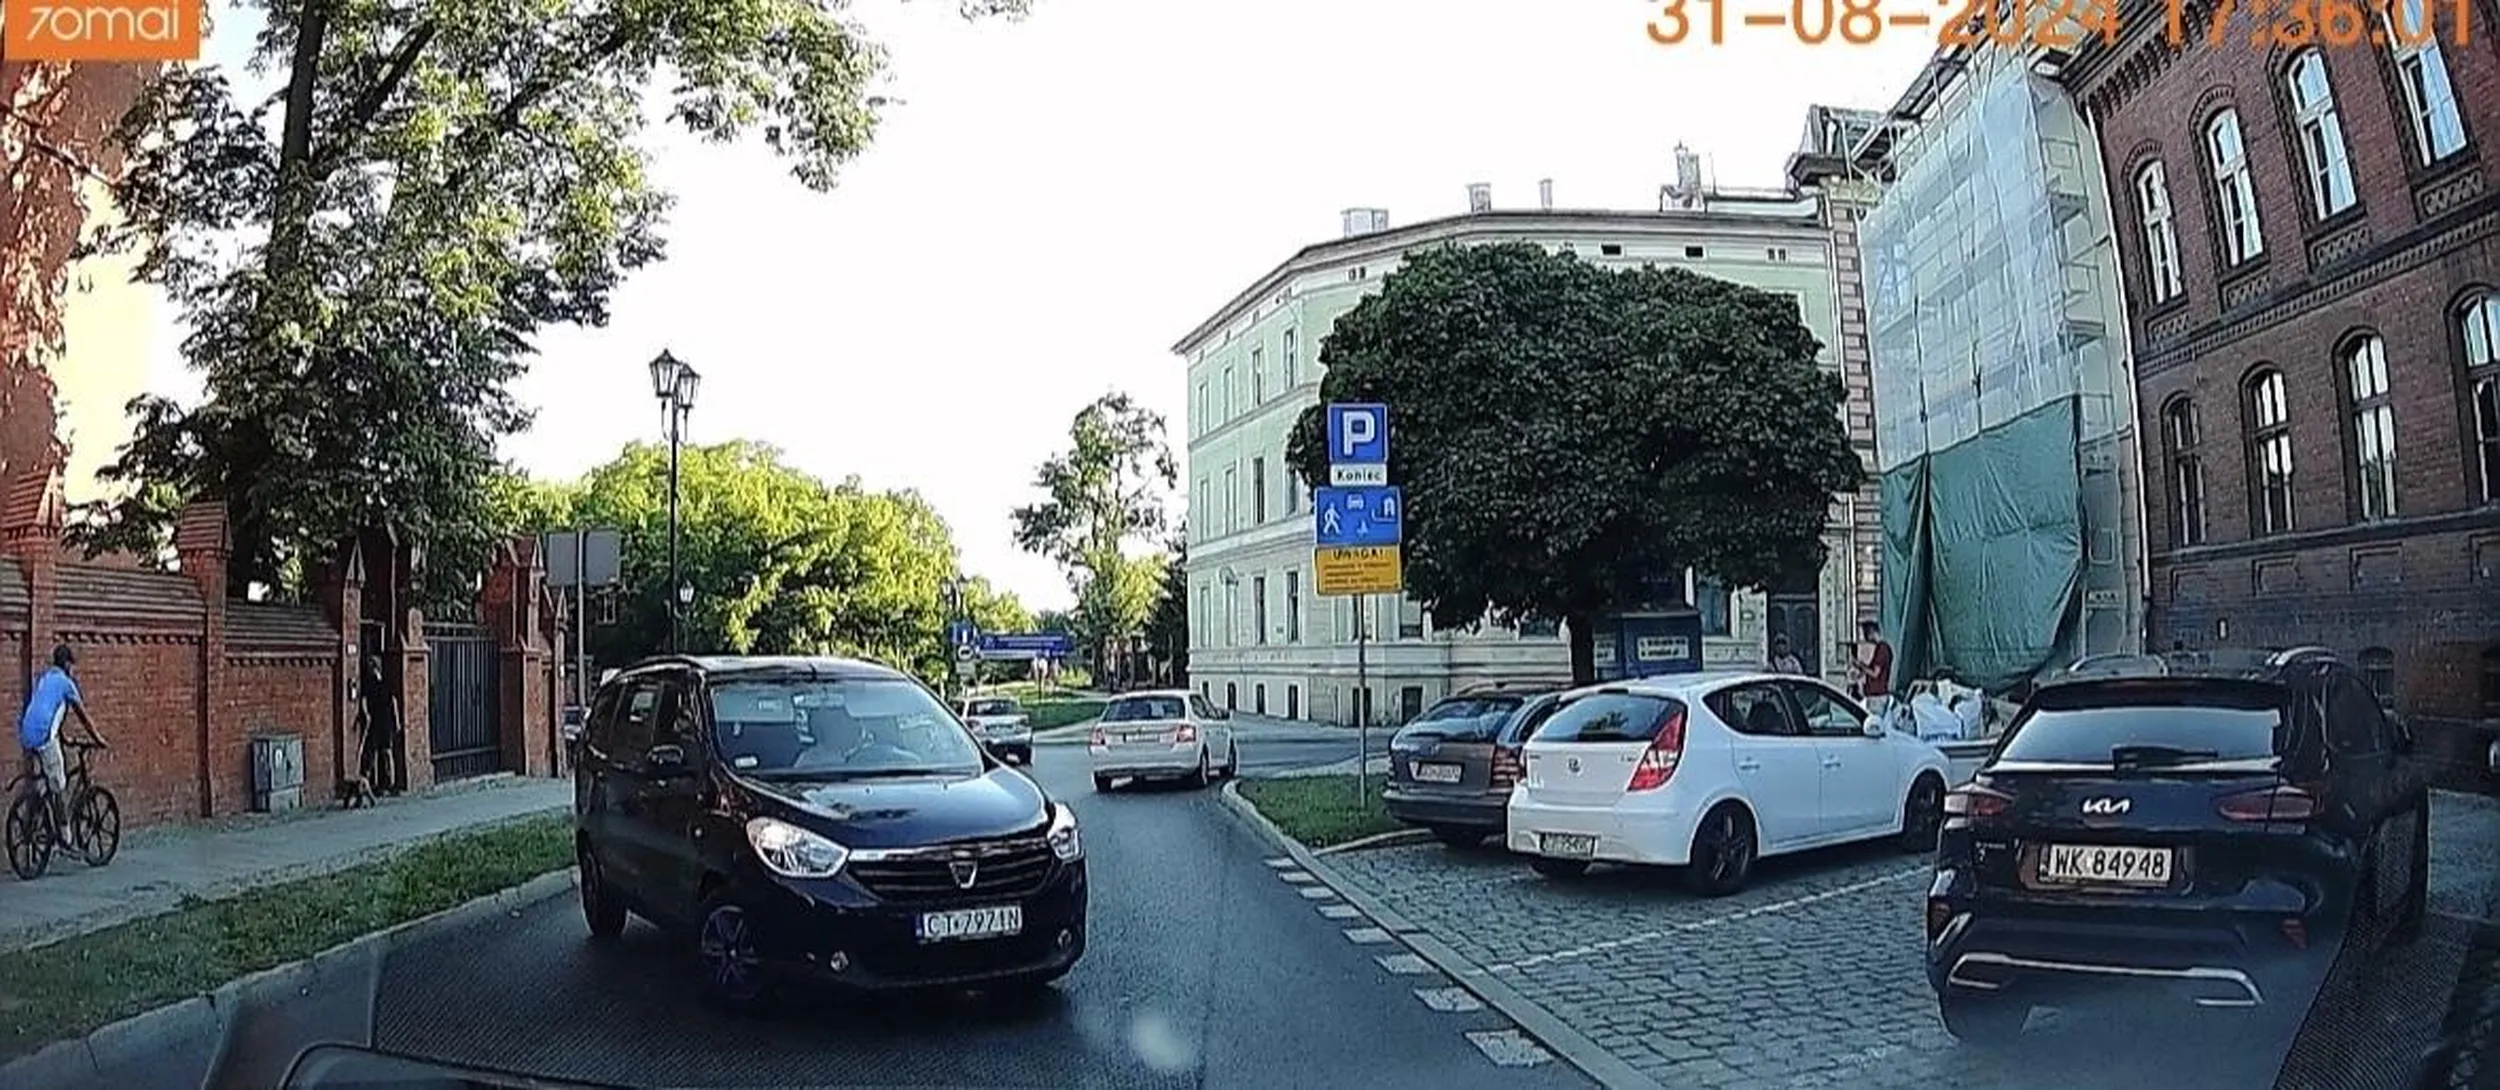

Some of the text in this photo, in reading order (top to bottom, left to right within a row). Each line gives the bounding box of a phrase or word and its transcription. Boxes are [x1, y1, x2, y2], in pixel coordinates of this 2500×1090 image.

[1343, 410, 1375, 456] P
[1337, 469, 1381, 481] Koniec
[2055, 848, 2165, 878] WK 84948
